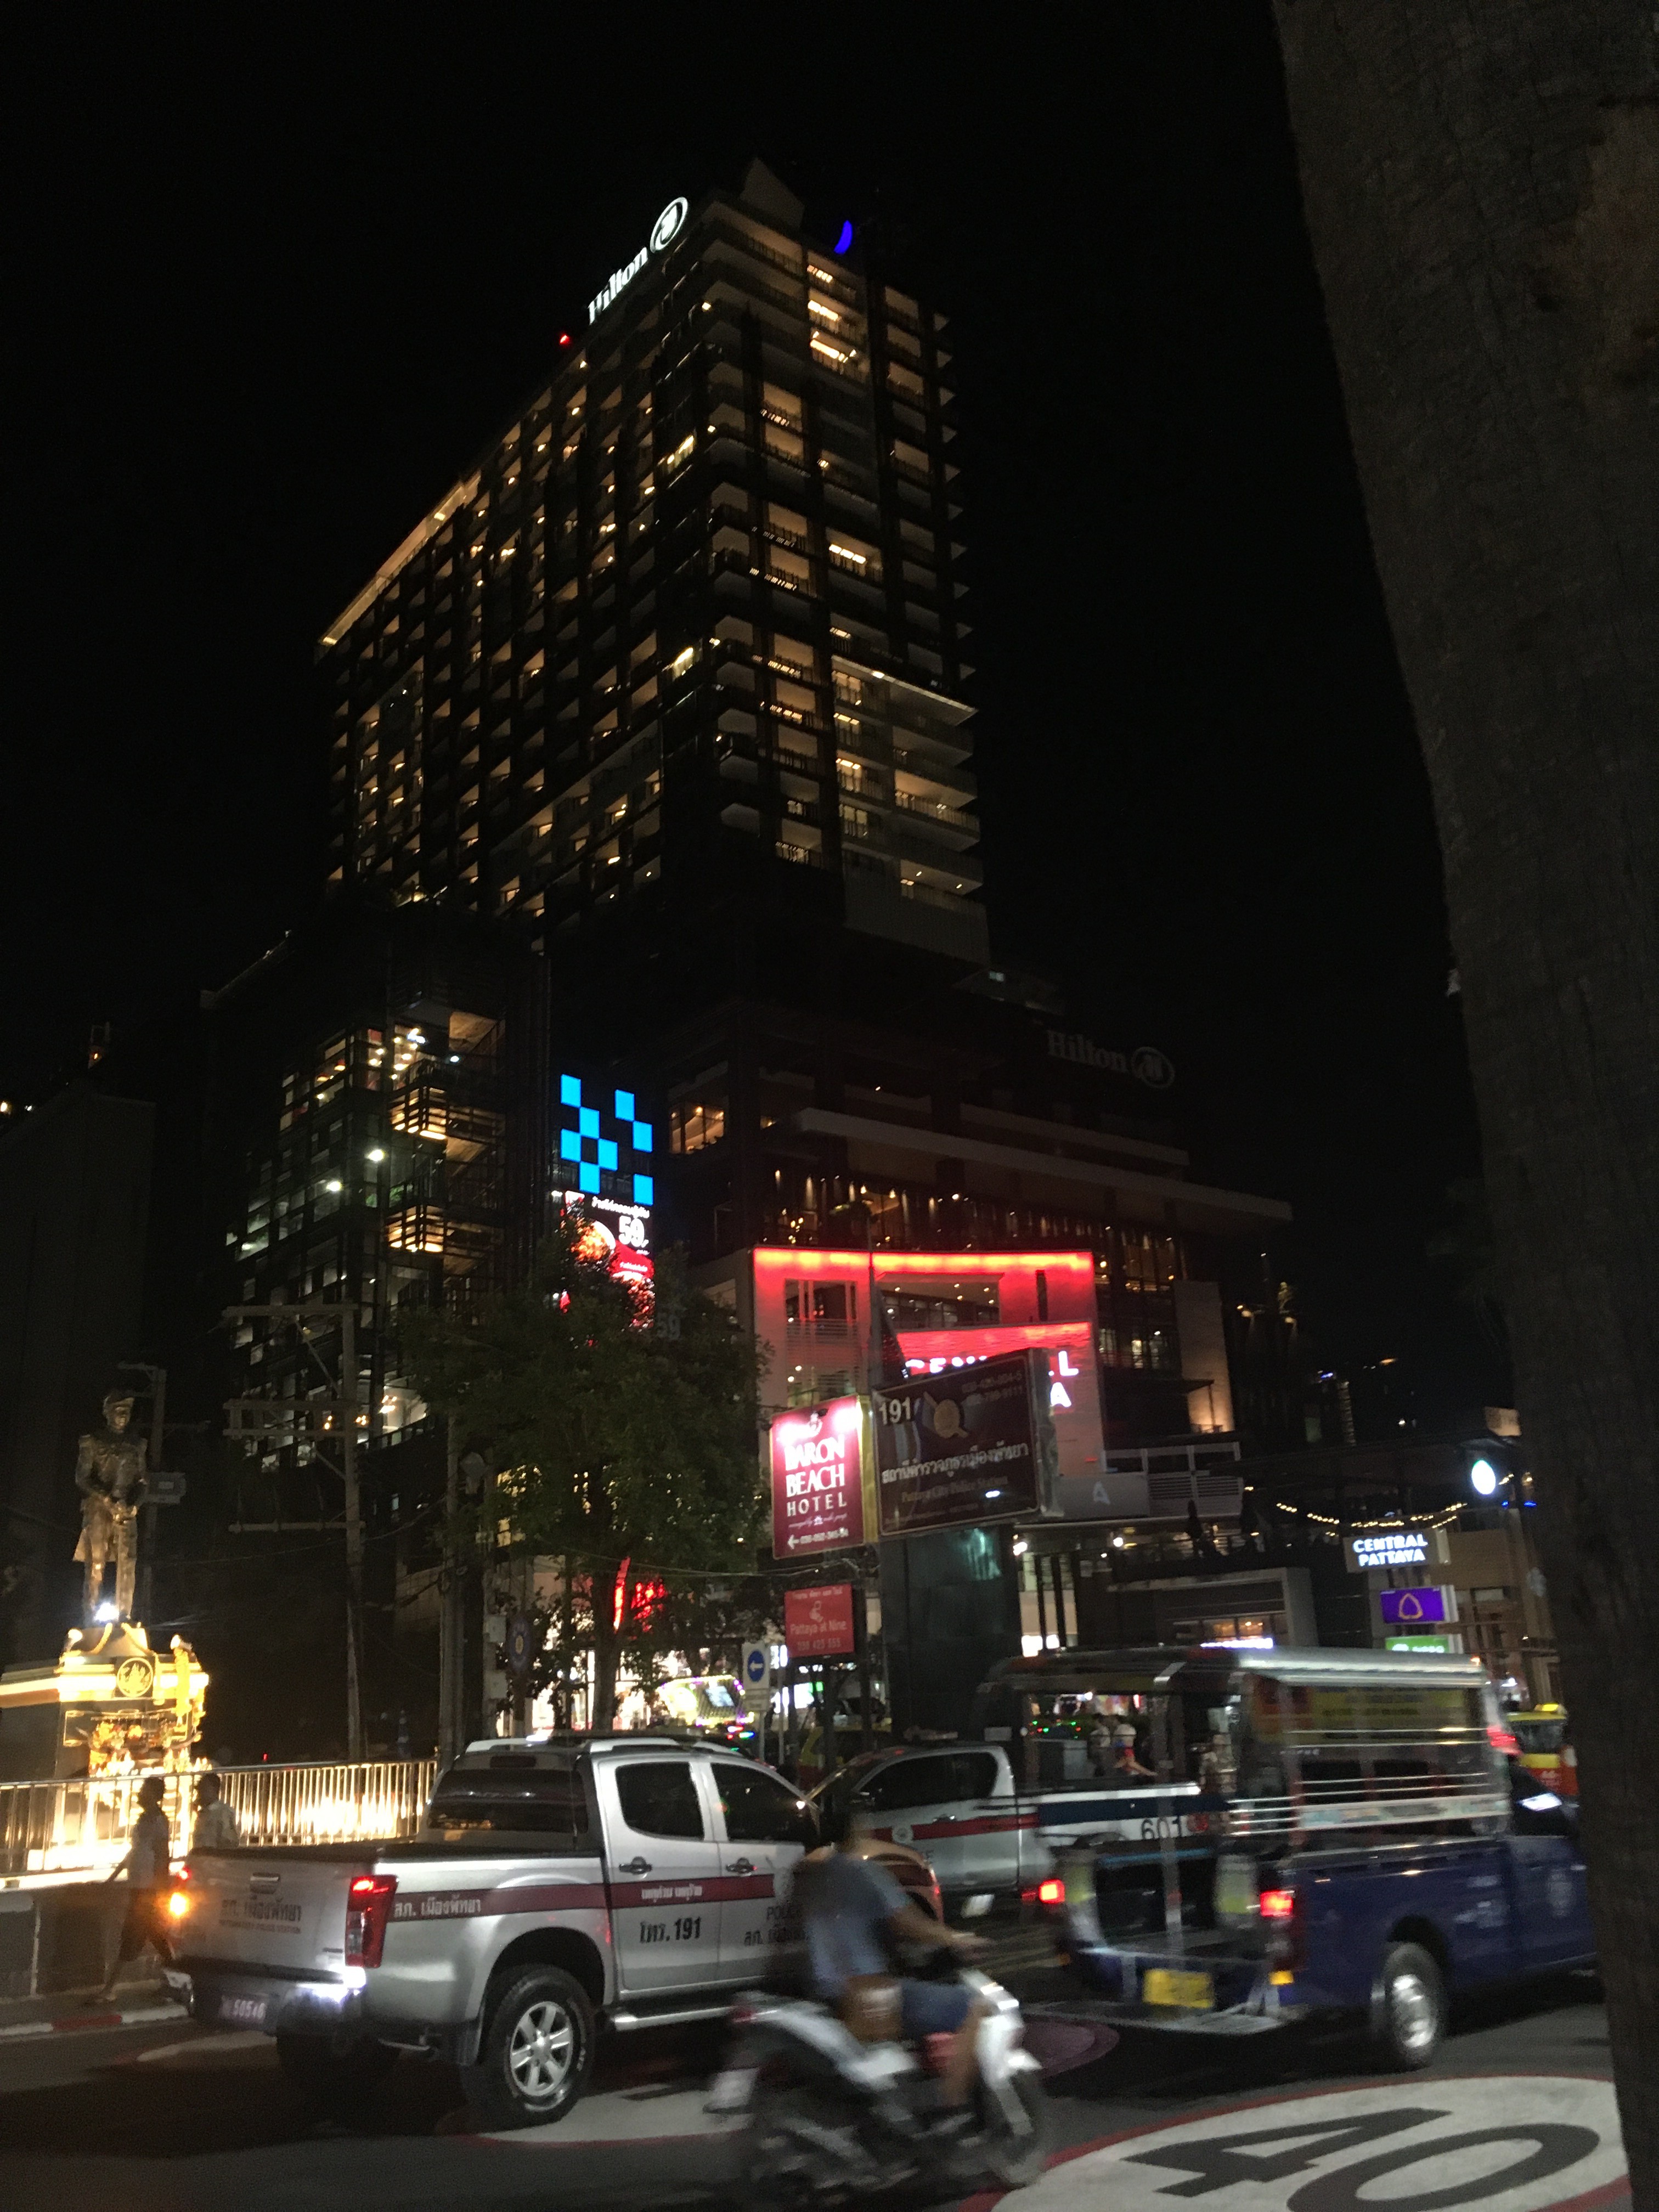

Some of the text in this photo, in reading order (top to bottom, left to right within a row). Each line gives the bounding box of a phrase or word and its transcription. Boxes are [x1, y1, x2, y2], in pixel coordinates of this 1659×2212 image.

[1046, 1029, 1129, 1075] Hilton
[879, 1396, 911, 1425] 191
[784, 1434, 845, 1471] BARON
[786, 1463, 845, 1498] BEACH
[787, 1492, 847, 1517] HOTEL
[1352, 1533, 1428, 1553] CENTRAL
[1358, 1549, 1426, 1567] PATTAYA
[673, 1916, 702, 1940] 191
[1121, 2107, 1601, 2212] 40
